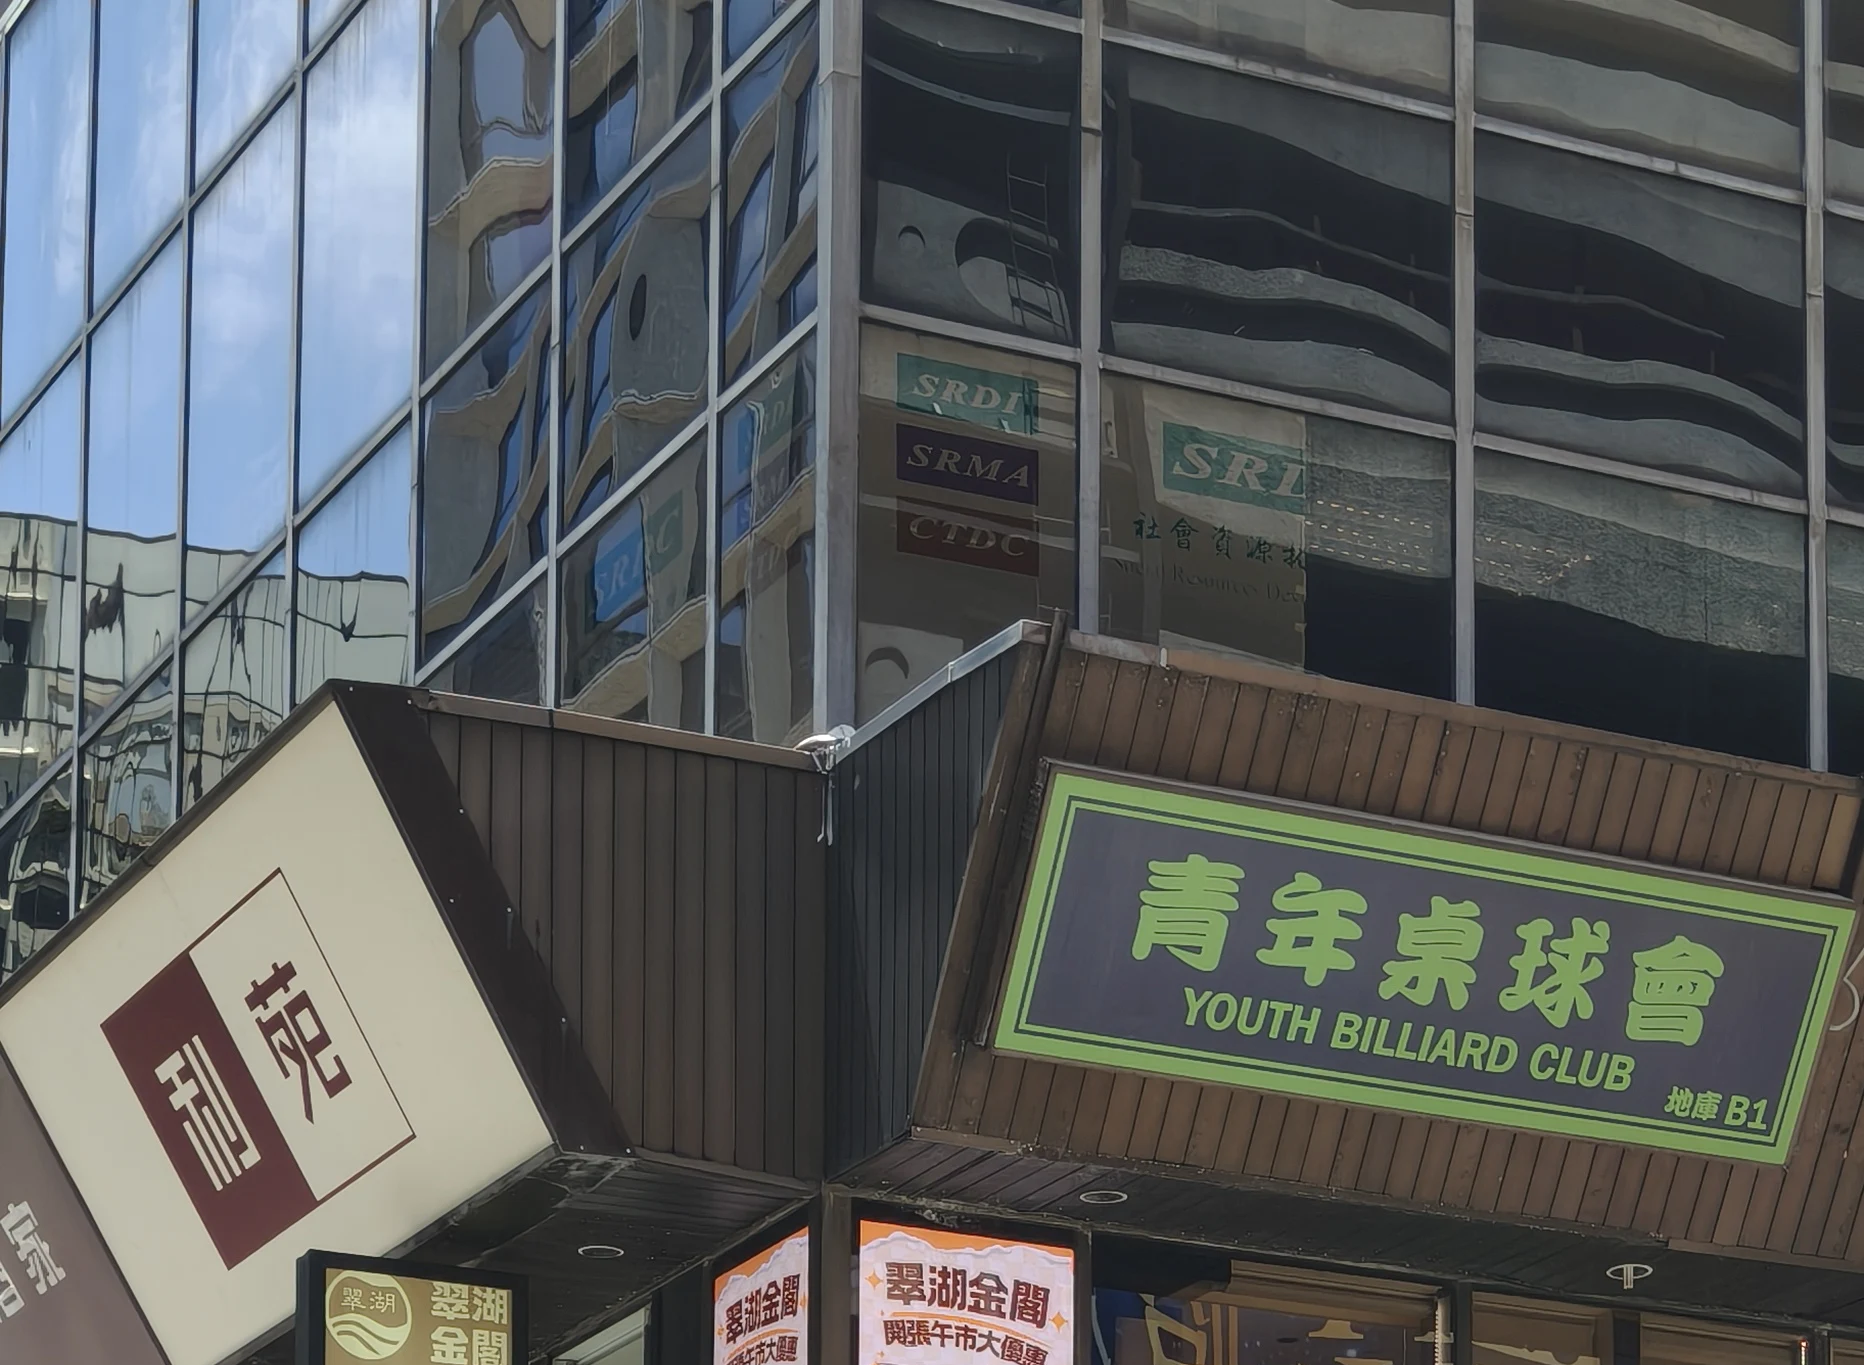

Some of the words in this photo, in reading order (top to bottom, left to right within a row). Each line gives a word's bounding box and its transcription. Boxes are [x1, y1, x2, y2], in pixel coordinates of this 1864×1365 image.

[912, 373, 1023, 415] SRDI
[906, 444, 1030, 488] SRMA
[908, 516, 1030, 557] CTDC
[1131, 852, 1726, 1048] 青年桌球會
[1183, 986, 1317, 1046] YOUTH
[1331, 1012, 1519, 1074] BILLIARD
[1529, 1041, 1637, 1092] CLUB
[154, 960, 353, 1192] 利苑
[1663, 1085, 1719, 1123] 地庫
[1723, 1094, 1769, 1131] B1
[340, 1286, 396, 1314] 翠湖
[429, 1281, 509, 1325] 翠湖
[725, 1273, 801, 1345] 翠湖金閣
[884, 1261, 1051, 1329] 翠湖金閣
